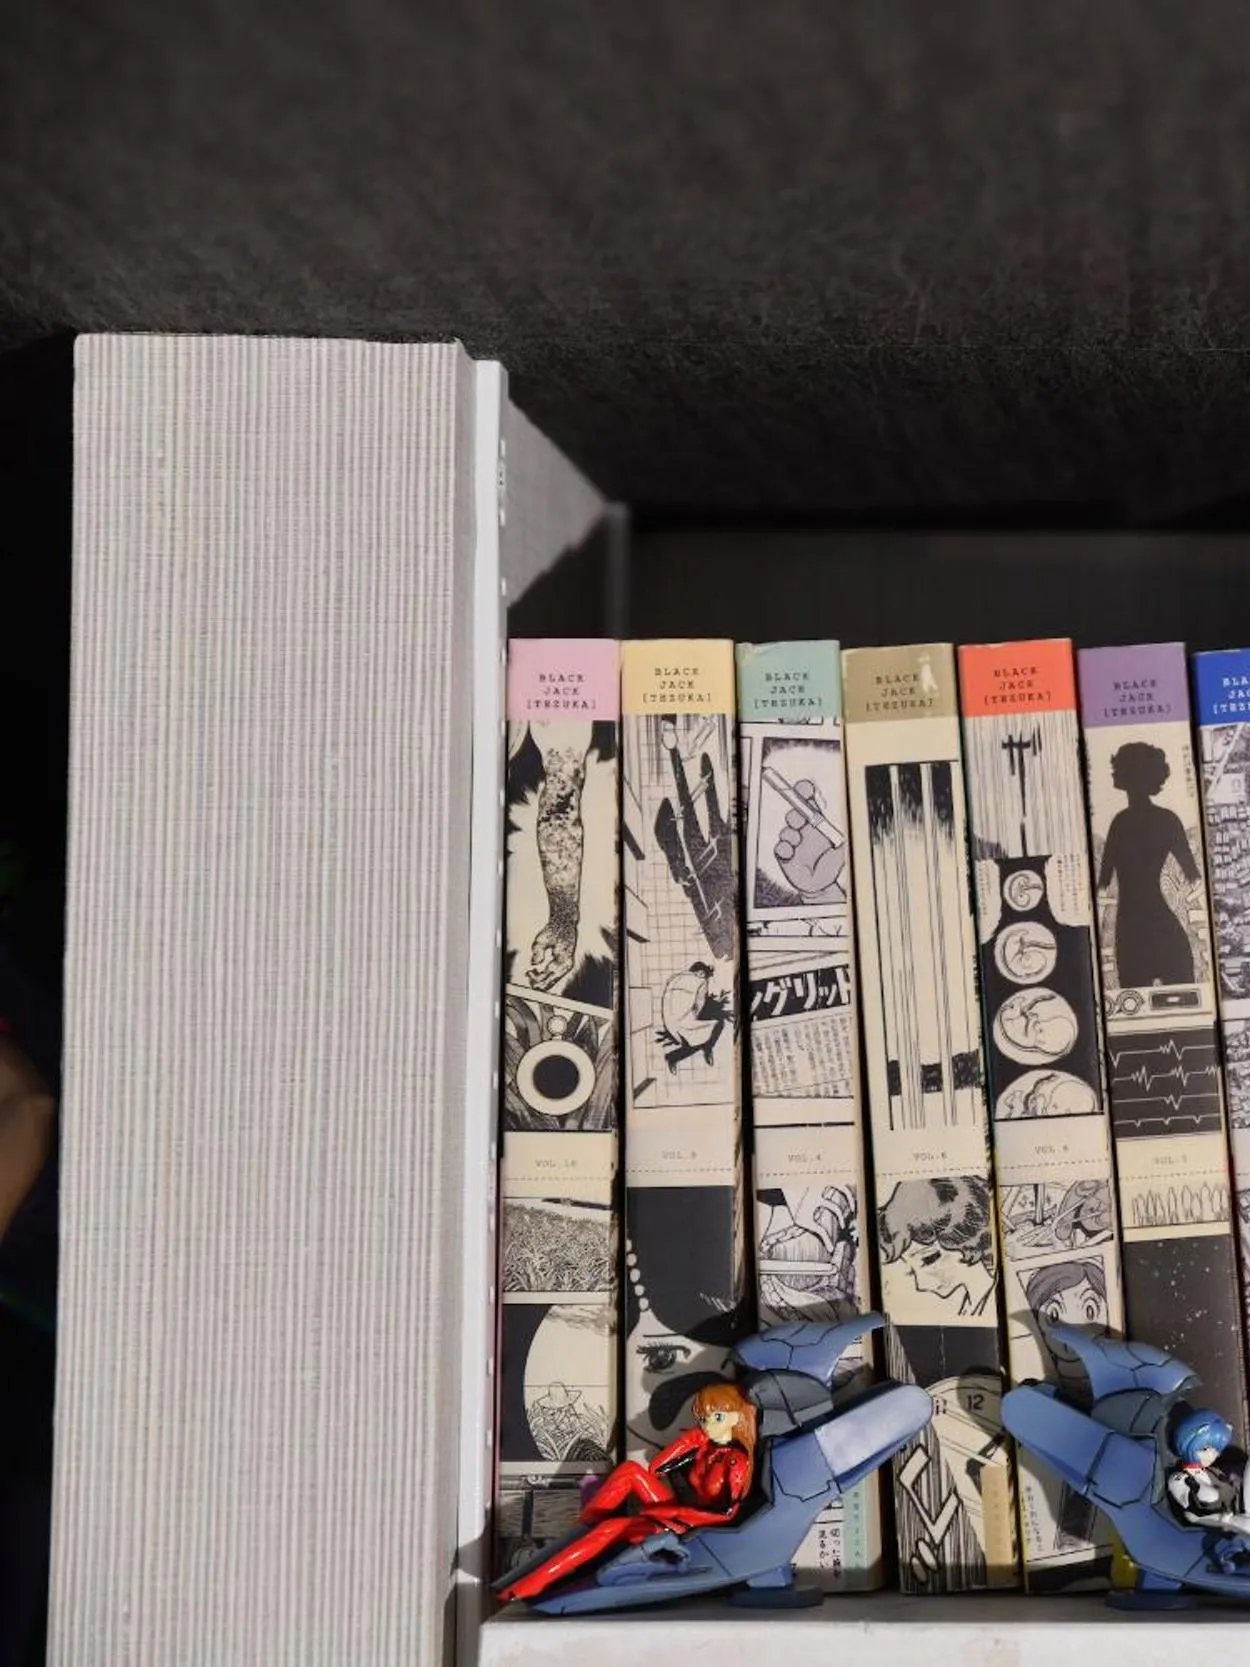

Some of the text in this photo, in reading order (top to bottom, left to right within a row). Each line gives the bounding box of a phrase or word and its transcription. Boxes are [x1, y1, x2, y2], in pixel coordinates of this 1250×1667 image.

[654, 667, 700, 676] BLACK
[994, 667, 1038, 677] BLACK
[539, 674, 585, 683] BLACK
[765, 672, 810, 682] BLACK
[875, 674, 920, 685] BLACK
[659, 680, 695, 690] JACK
[769, 685, 805, 695] JACK
[999, 680, 1034, 690] JACK
[1113, 679, 1158, 691] BLACK
[544, 687, 580, 696] JACK
[881, 687, 915, 697] JACK
[1119, 692, 1154, 703] JACK
[968, 1394, 985, 1412] 12
